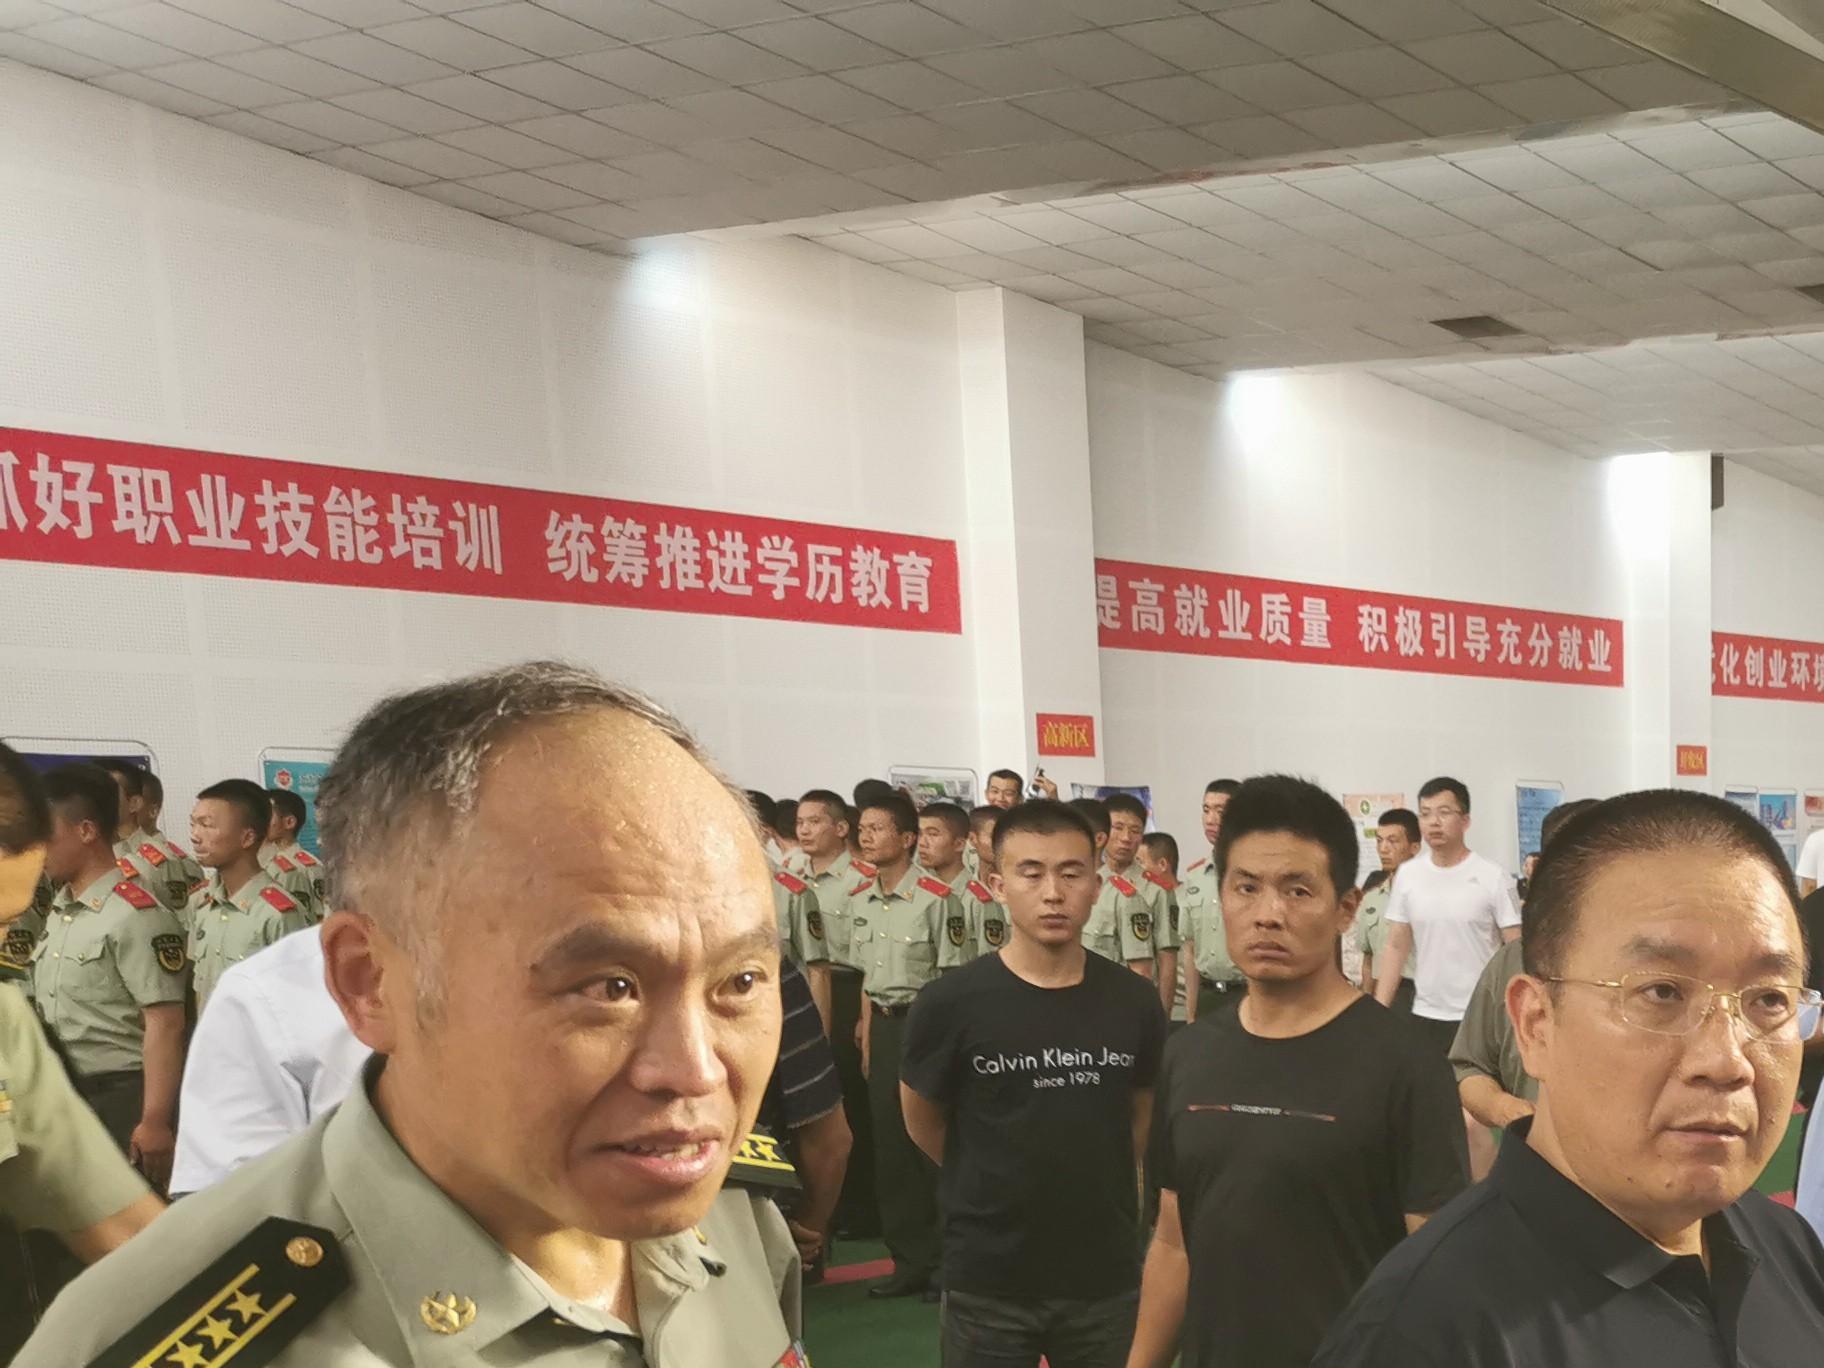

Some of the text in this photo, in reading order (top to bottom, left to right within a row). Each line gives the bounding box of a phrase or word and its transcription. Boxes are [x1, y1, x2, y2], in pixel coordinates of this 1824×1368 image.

[545, 510, 933, 613] 统筹推进学历教育
[1358, 604, 1612, 673] 积极引导充分就业
[972, 1052, 1038, 1074] Calvin
[1042, 1046, 1094, 1068] Klein
[1033, 1071, 1101, 1089] since 1978
